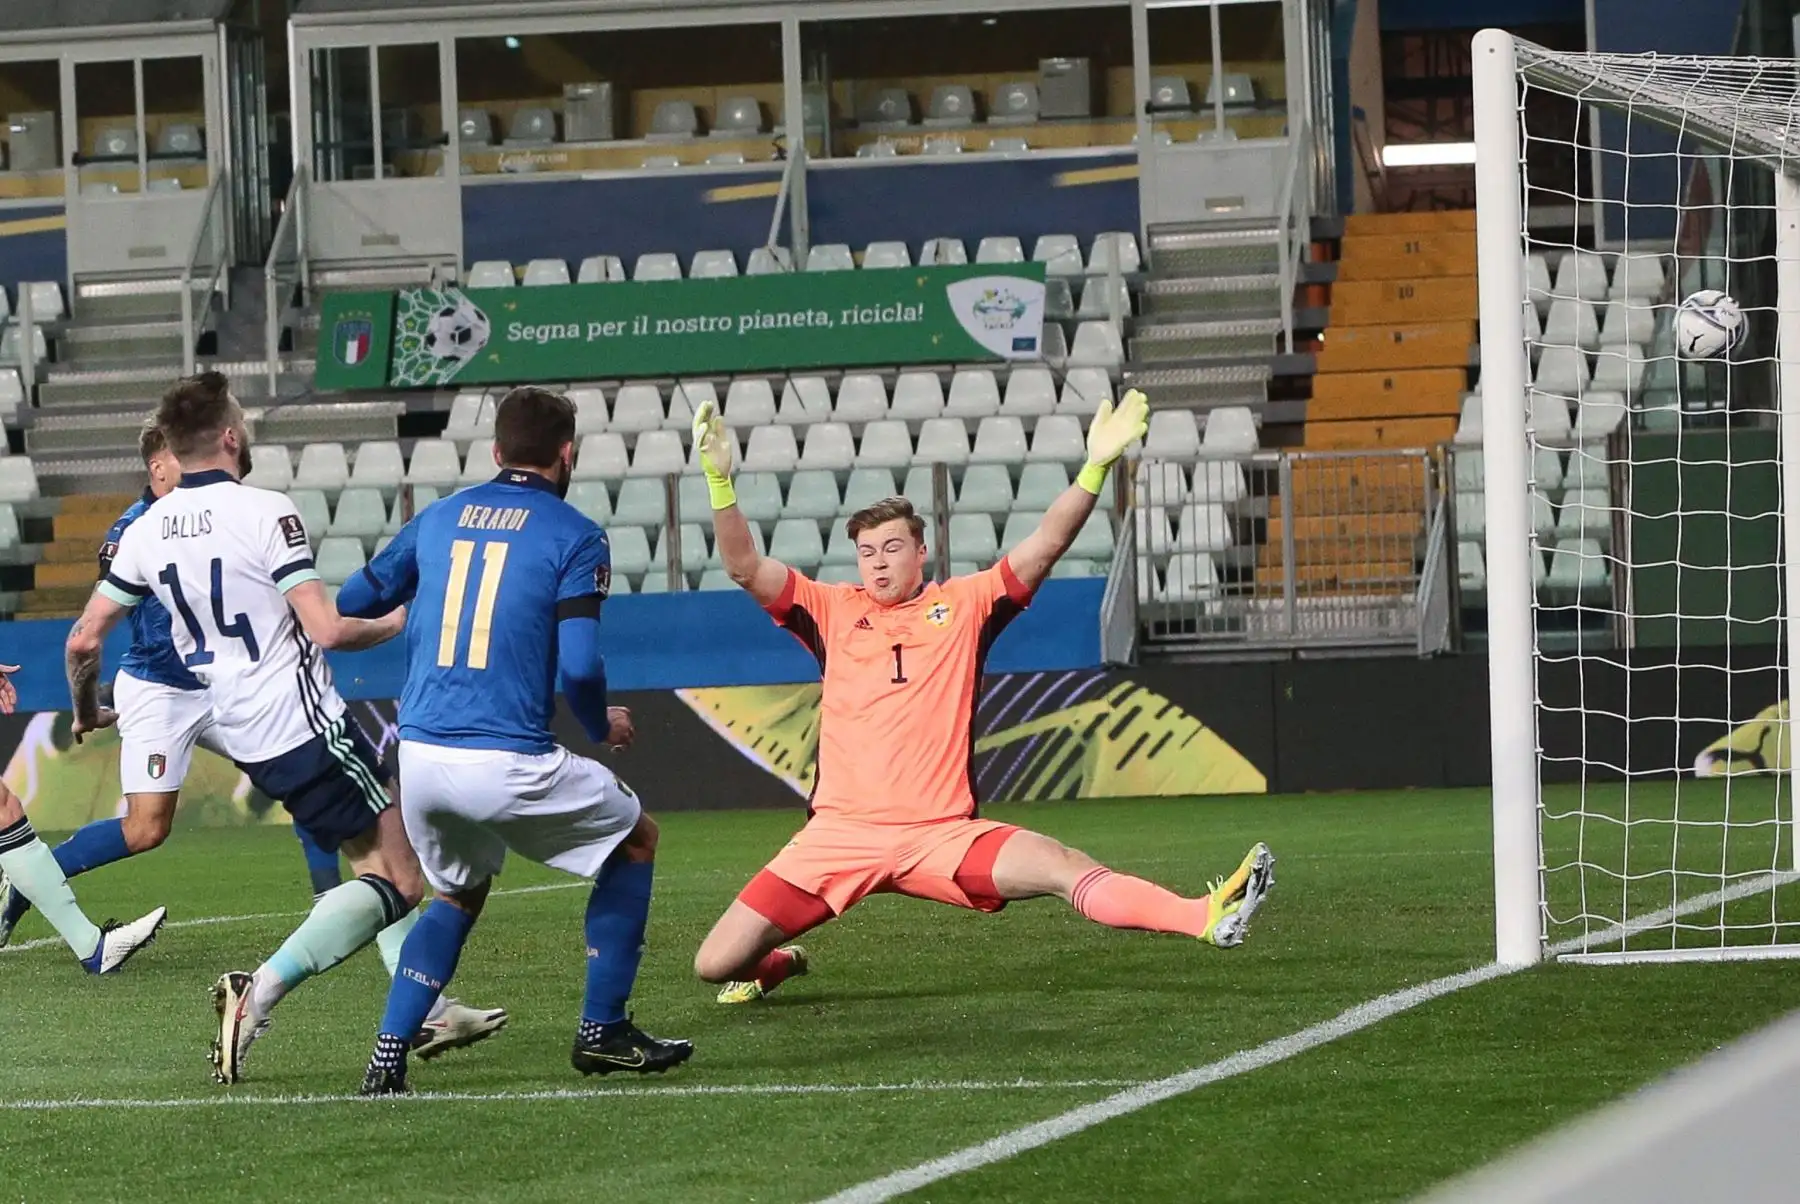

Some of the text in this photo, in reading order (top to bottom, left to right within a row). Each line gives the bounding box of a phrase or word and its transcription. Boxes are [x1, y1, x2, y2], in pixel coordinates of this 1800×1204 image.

[507, 302, 924, 344] Segna per il nostro pianeta, ricicla!
[161, 510, 213, 540] DALLAS
[457, 504, 530, 531] BERARDI
[158, 557, 260, 667] 14
[436, 539, 509, 670] 11
[891, 643, 908, 684] 1
[402, 967, 441, 989] ITALIA
